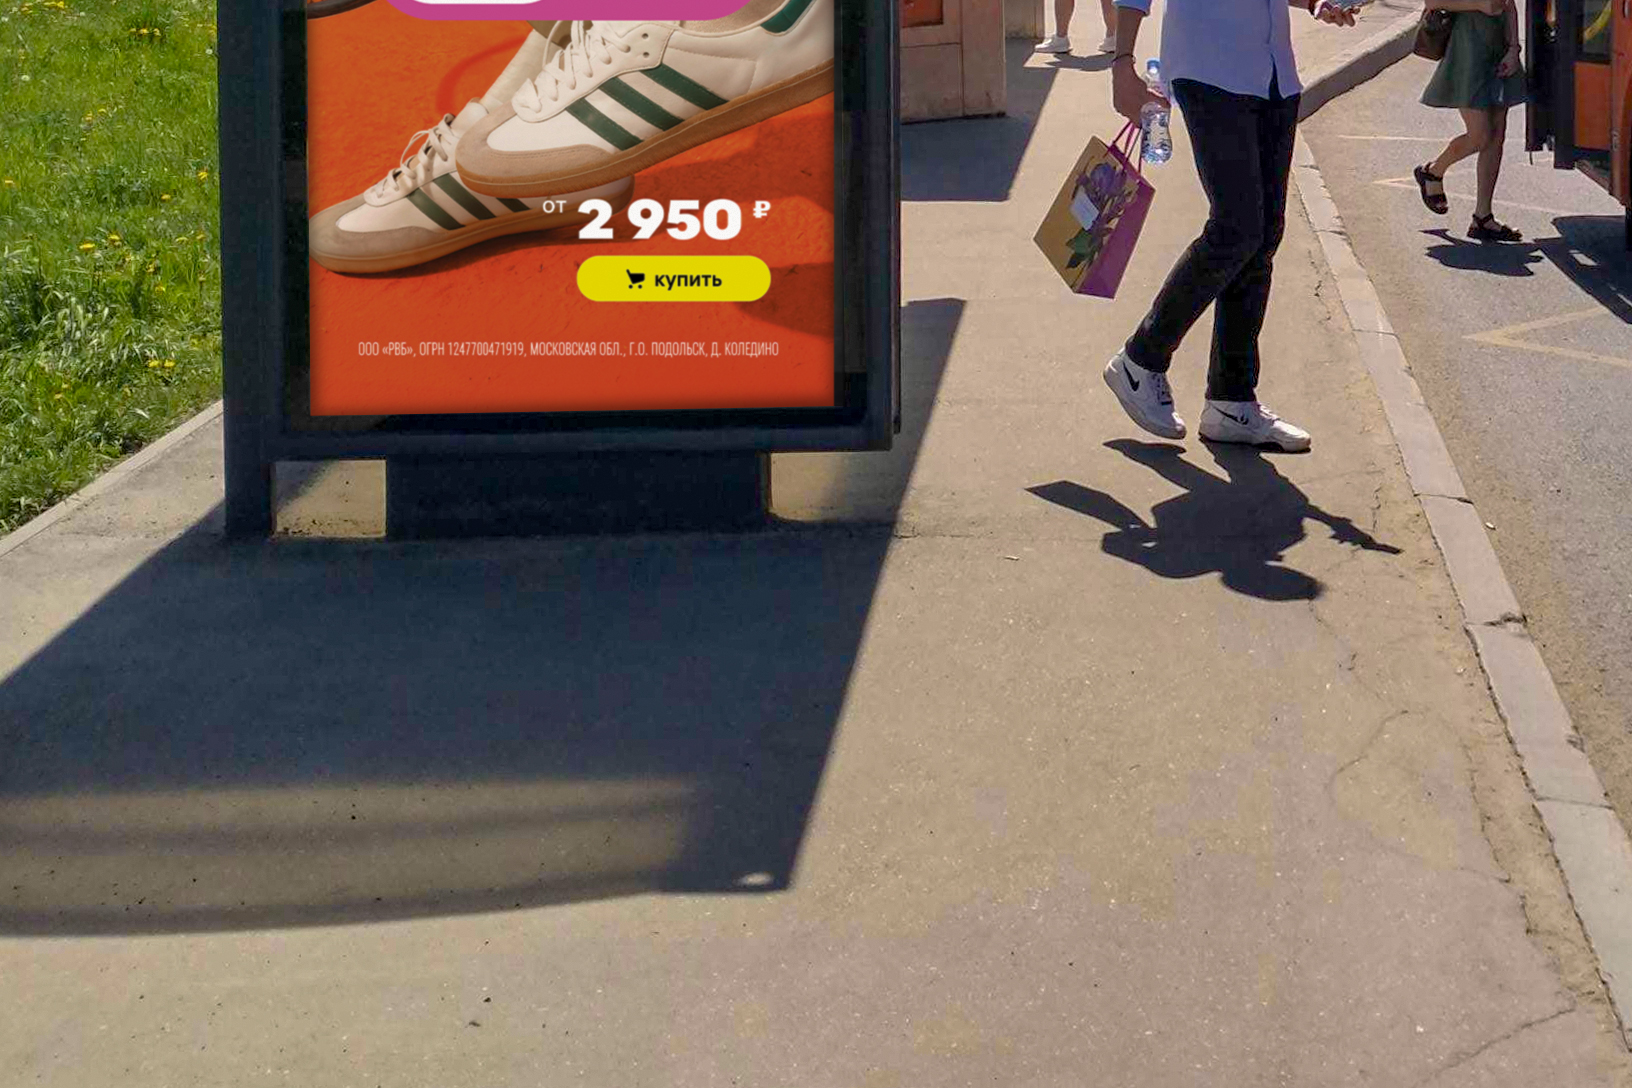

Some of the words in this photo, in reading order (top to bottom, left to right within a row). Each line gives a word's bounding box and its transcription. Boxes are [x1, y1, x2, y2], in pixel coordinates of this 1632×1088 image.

[542, 200, 567, 214] от
[654, 274, 722, 291] купить
[358, 341, 380, 356] ООО
[419, 341, 445, 356] ОГРН
[530, 341, 596, 356] МОСКОВСКАЯ
[629, 341, 648, 356] Г.О.
[651, 341, 708, 358] ПОДОЛЬСК,
[711, 341, 721, 358] Д.
[725, 341, 779, 358] КОЛЕДИНО
